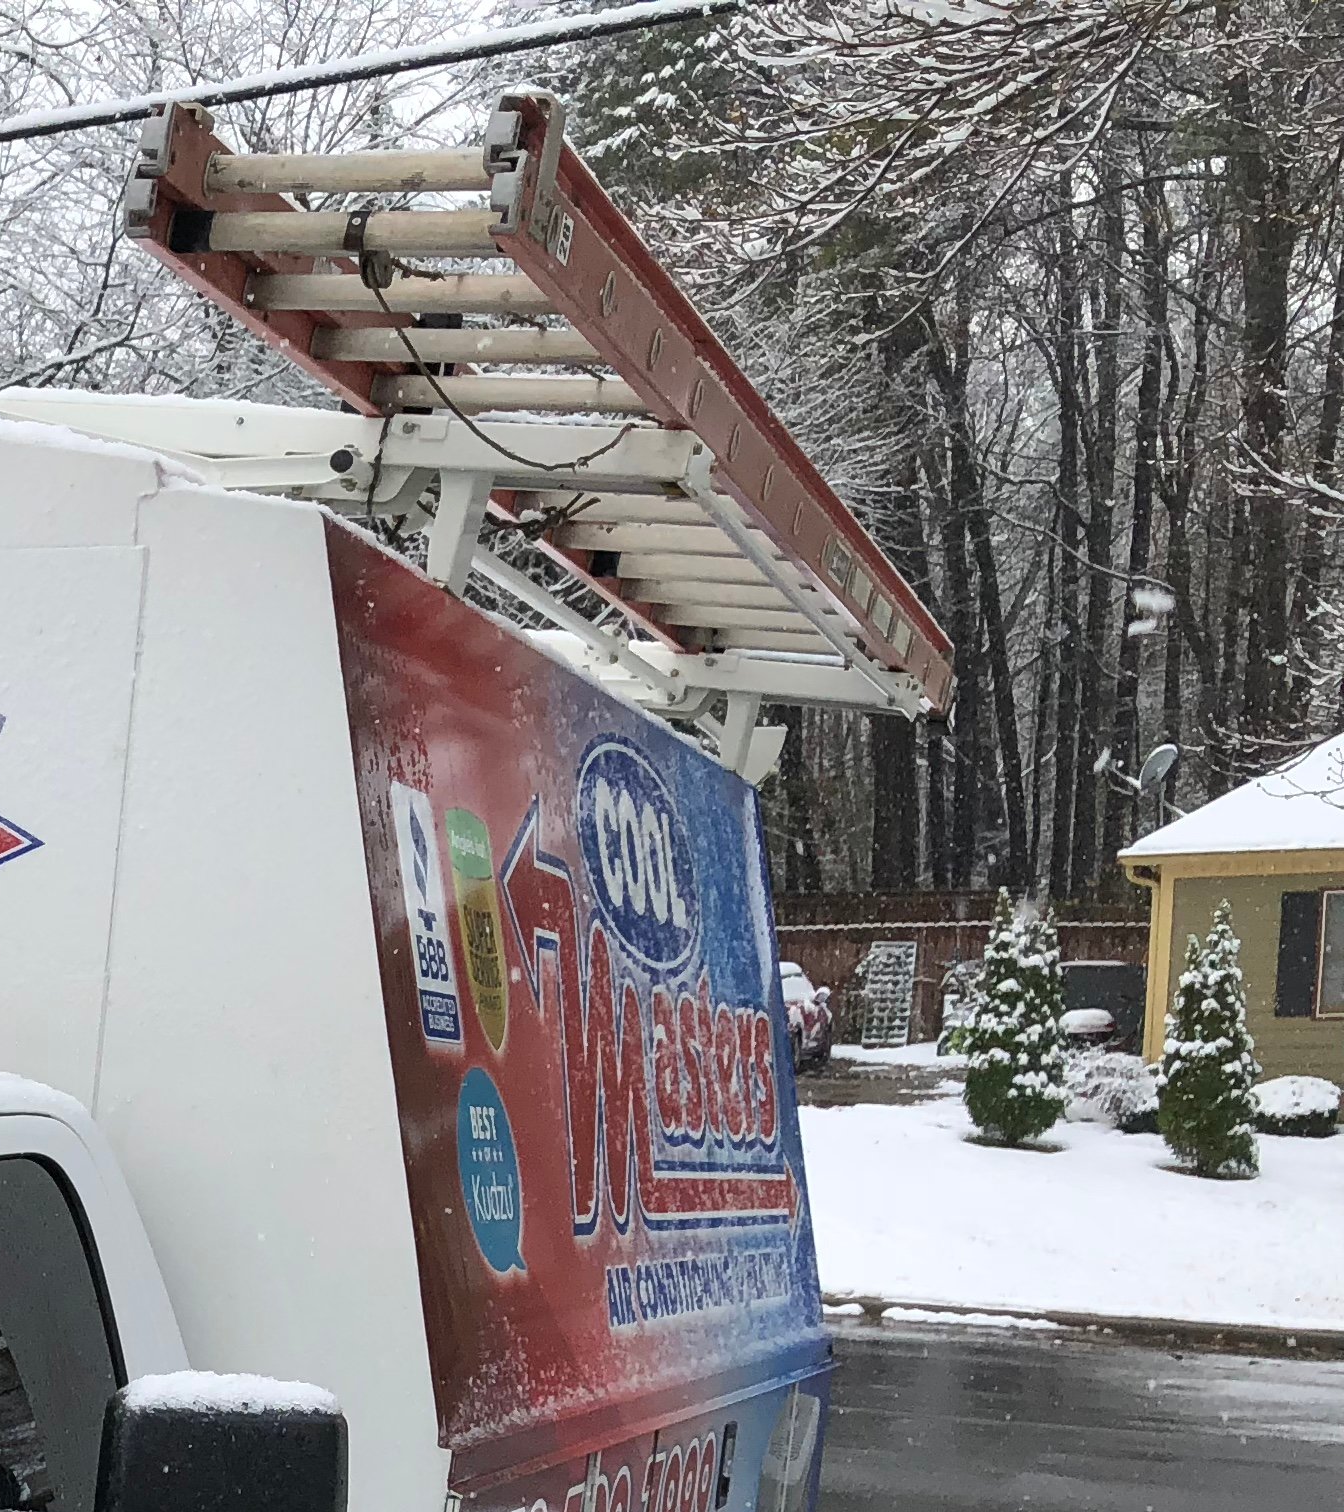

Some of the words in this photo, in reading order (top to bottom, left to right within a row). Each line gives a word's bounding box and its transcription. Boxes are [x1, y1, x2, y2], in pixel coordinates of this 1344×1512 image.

[595, 776, 688, 931] COOL
[416, 934, 449, 982] BBB
[566, 860, 780, 1238] Masters
[469, 1105, 498, 1141] BEST
[471, 1171, 514, 1222] Kudzu
[606, 1266, 638, 1328] AIR
